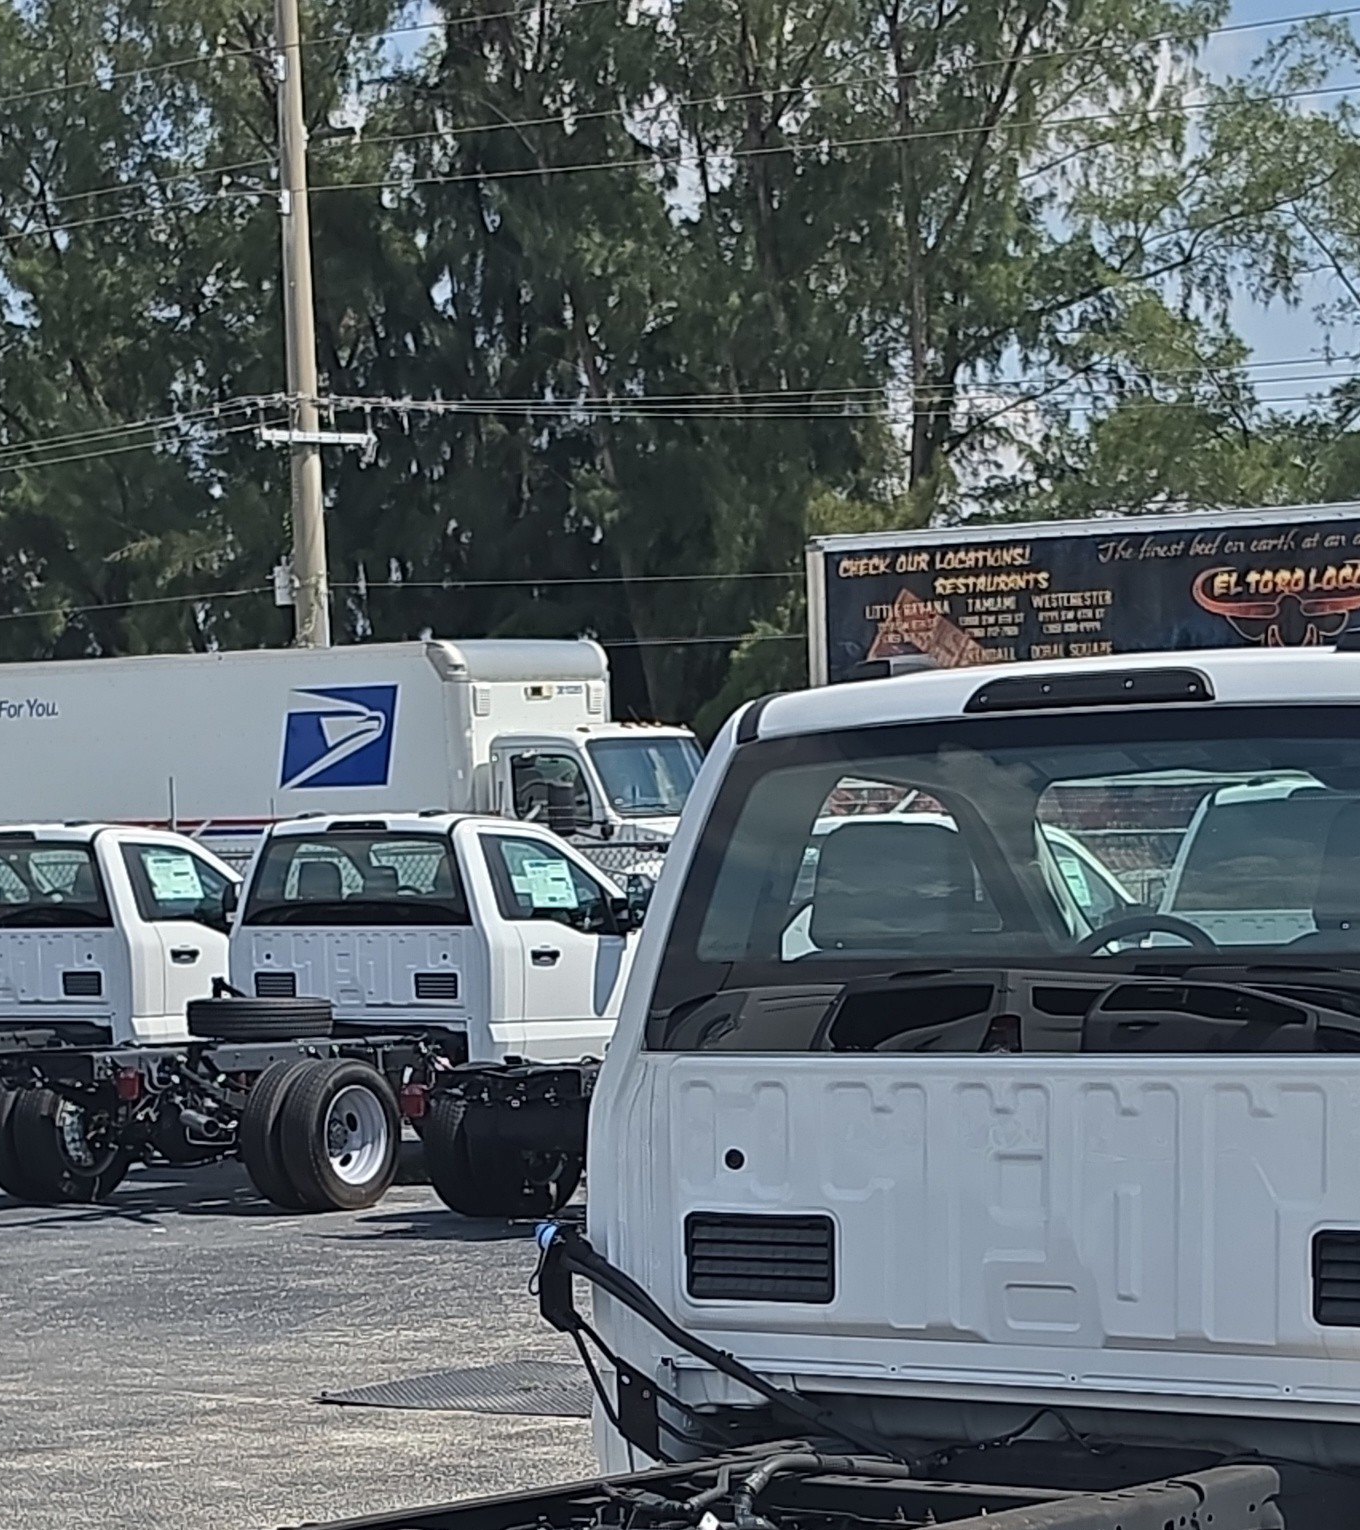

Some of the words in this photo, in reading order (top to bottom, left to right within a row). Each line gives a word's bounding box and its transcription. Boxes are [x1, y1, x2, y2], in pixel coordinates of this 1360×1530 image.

[839, 554, 892, 578] CHECK
[896, 552, 930, 573] OUR
[935, 545, 1031, 570] LOCATIONS!
[1097, 538, 1131, 563] The
[1137, 535, 1185, 561] finest
[1189, 532, 1226, 556] beef
[1224, 539, 1245, 552] on
[1250, 529, 1296, 551] earth
[1301, 532, 1323, 549] at
[1324, 533, 1346, 548] an
[933, 571, 1050, 595] RESTAURANTS
[1213, 571, 1243, 597] EL
[1246, 567, 1305, 594] TORO
